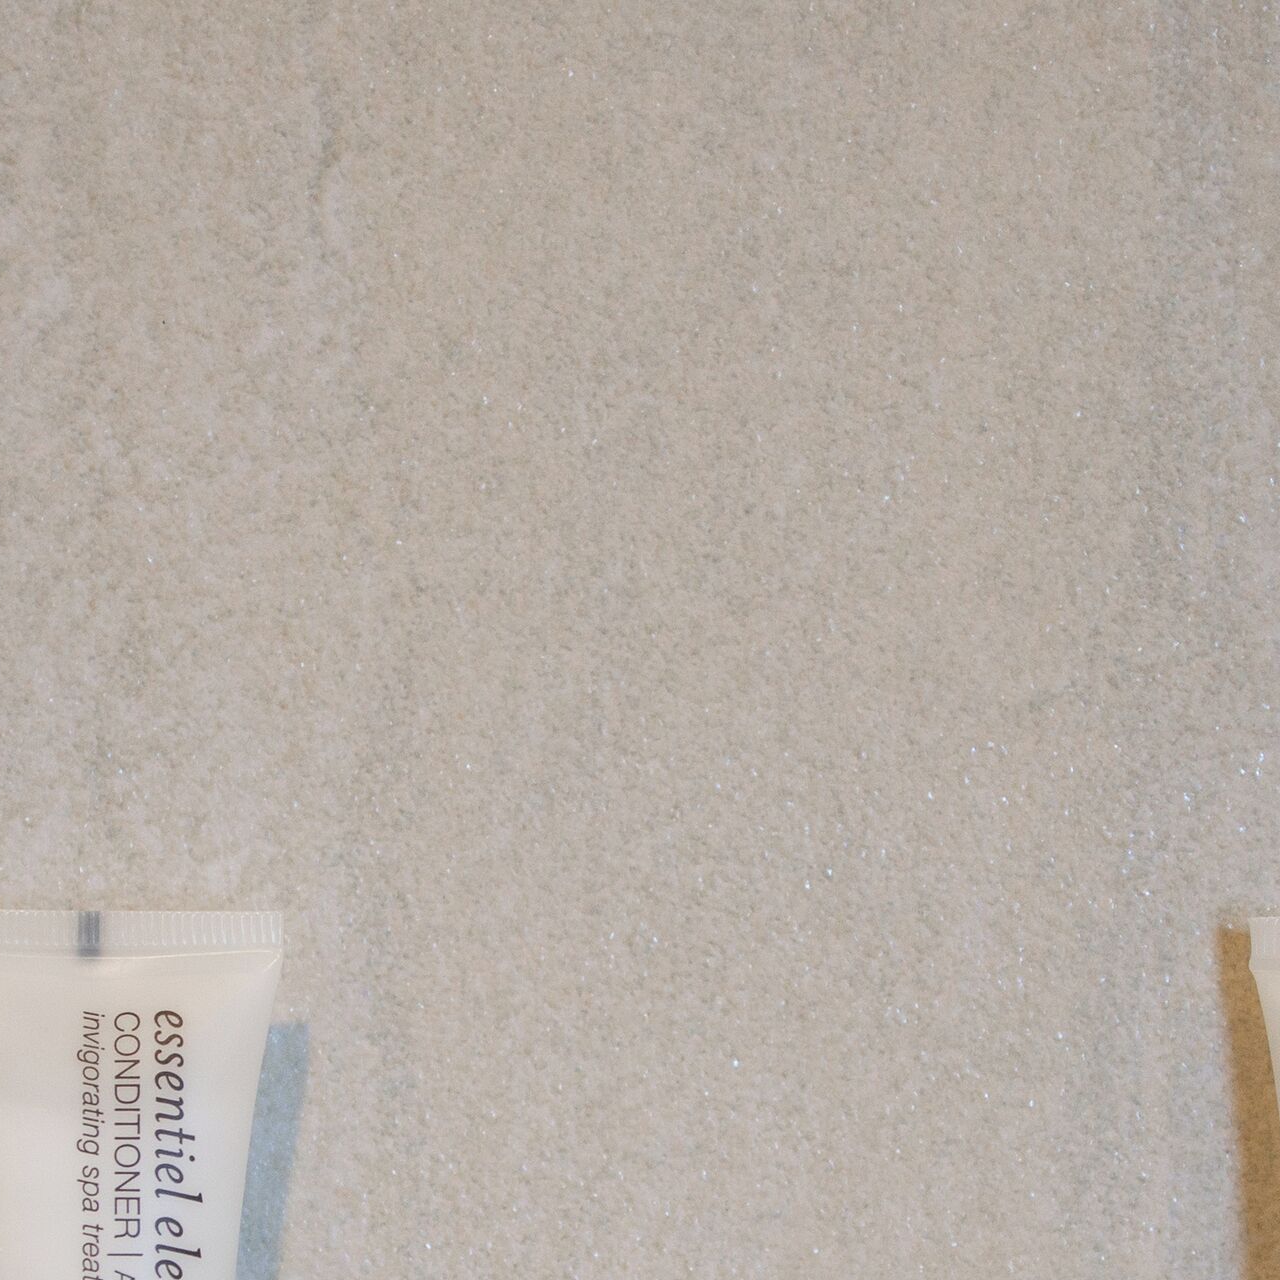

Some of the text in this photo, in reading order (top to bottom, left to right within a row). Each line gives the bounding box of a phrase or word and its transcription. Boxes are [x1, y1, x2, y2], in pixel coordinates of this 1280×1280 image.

[77, 1011, 104, 1155] invigorating
[113, 1011, 141, 1239] CONDITIONER
[154, 1010, 203, 1203] essentiel
[77, 1165, 100, 1213] spa
